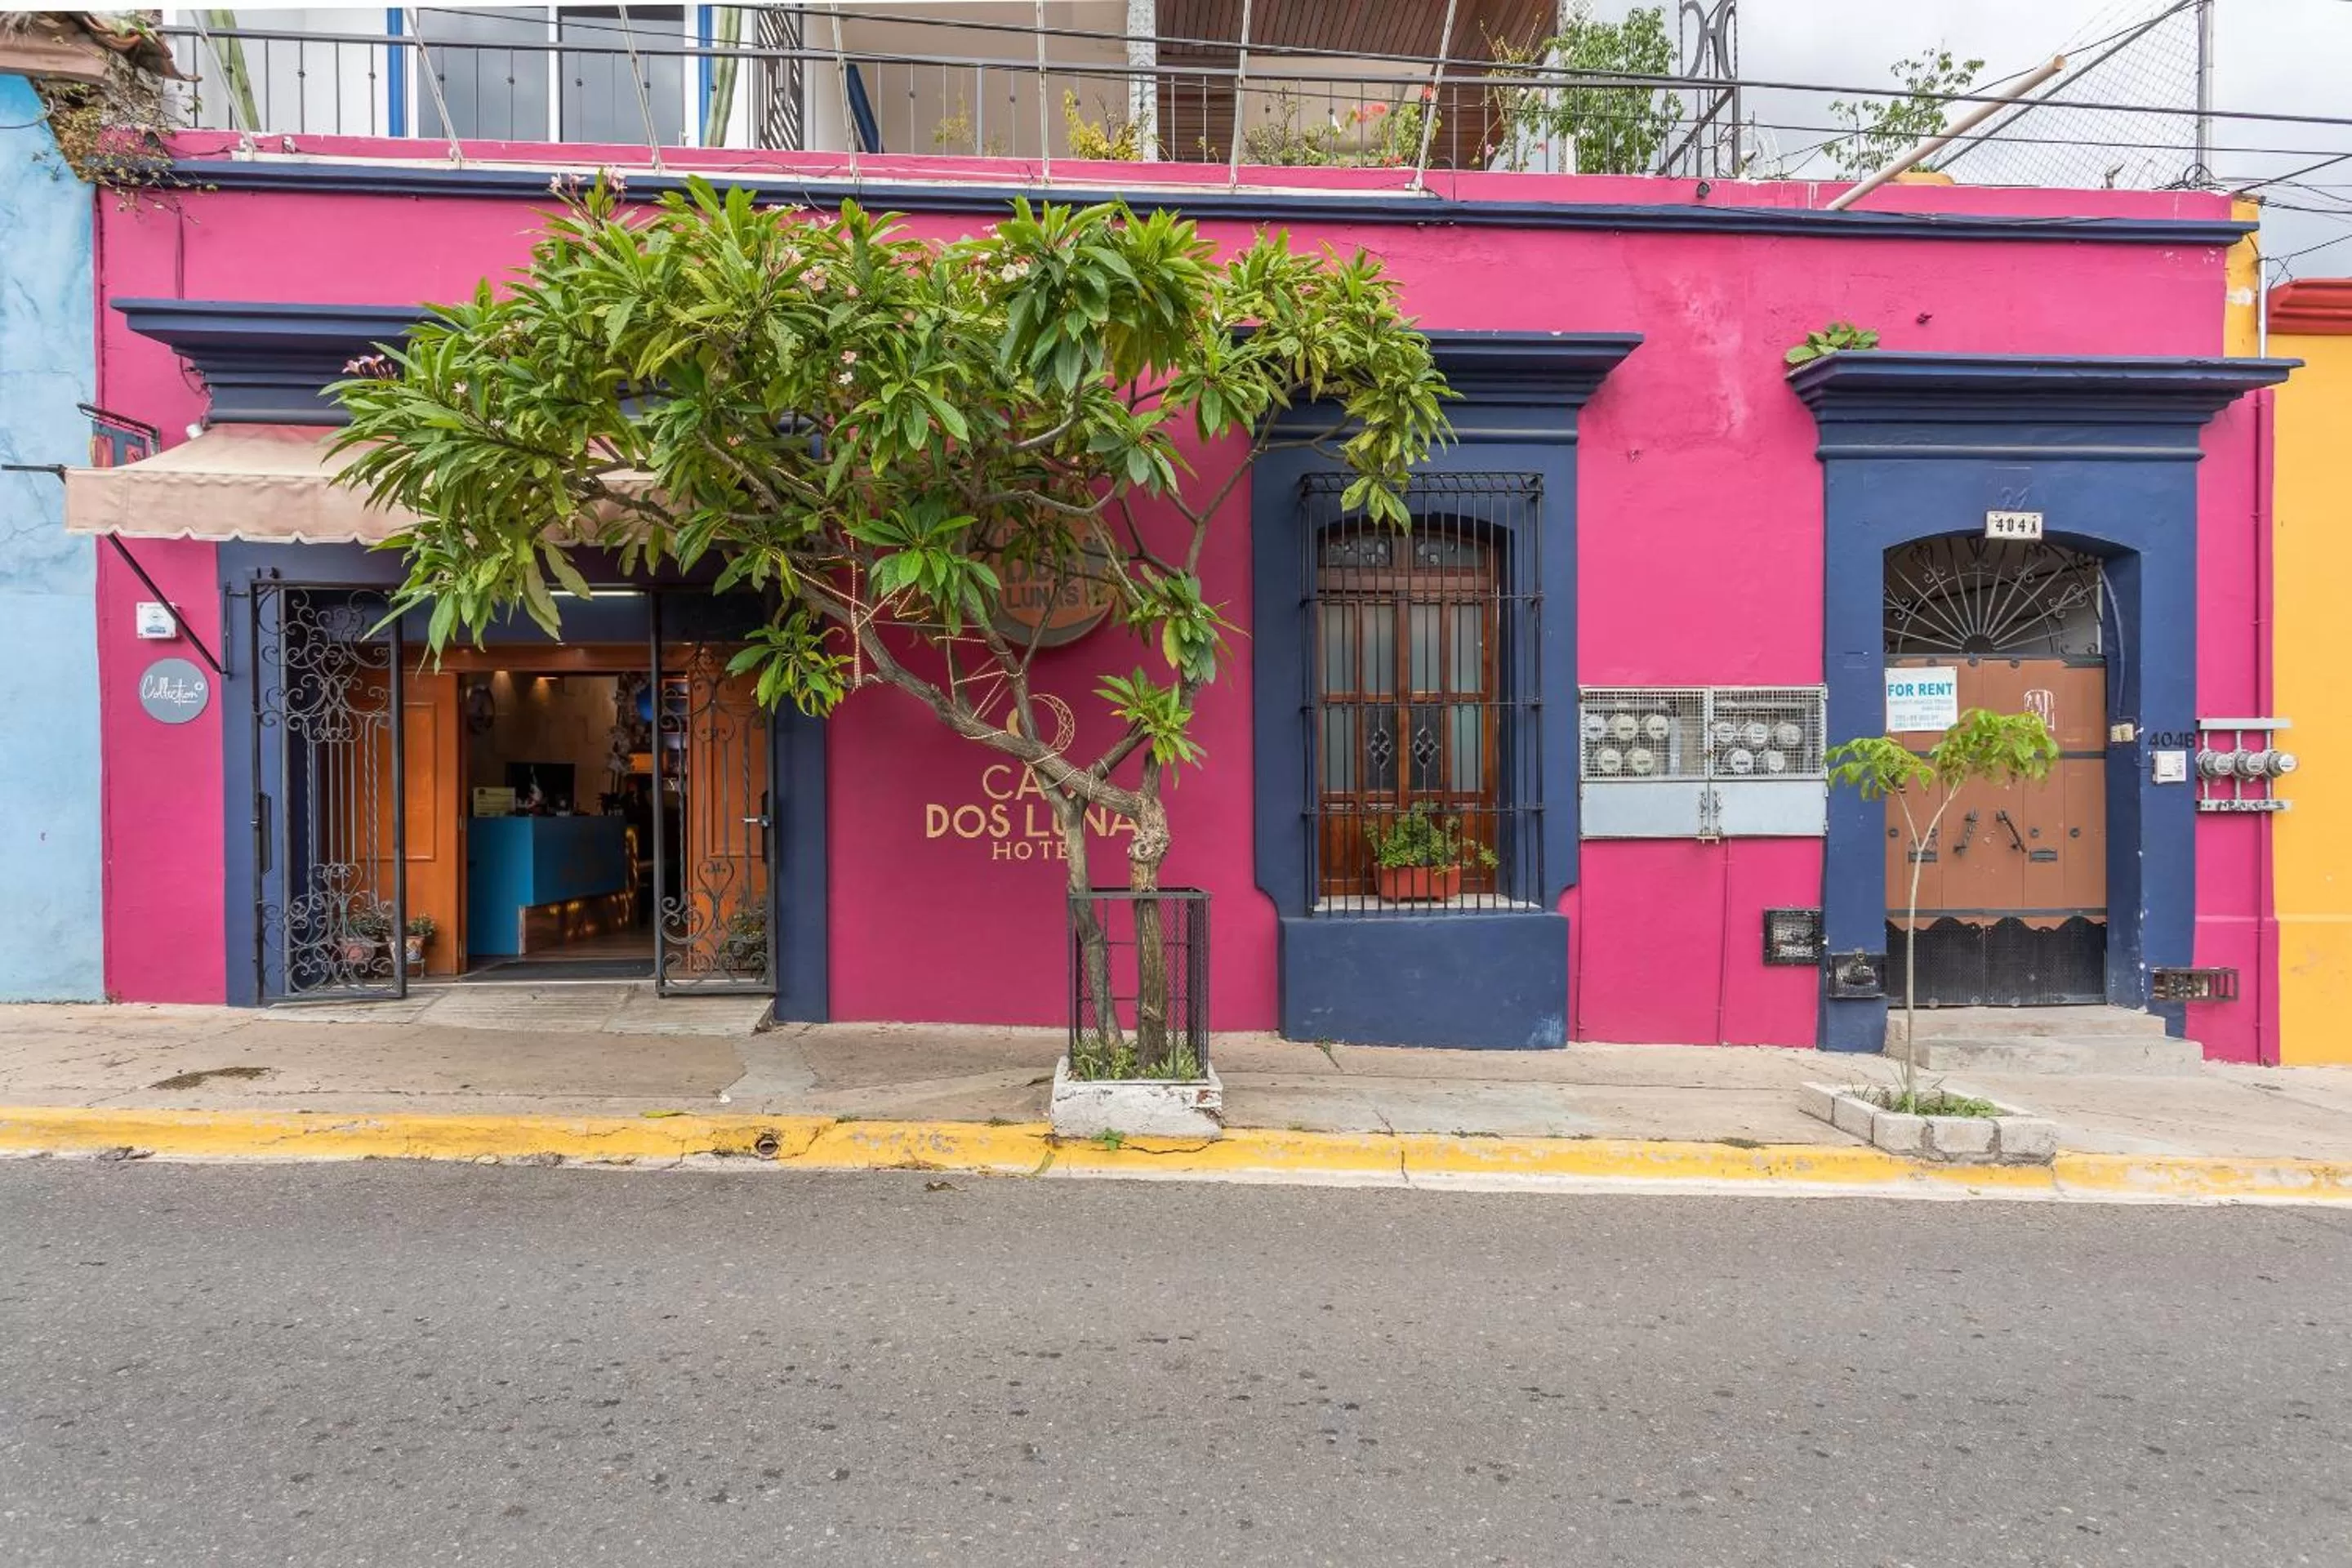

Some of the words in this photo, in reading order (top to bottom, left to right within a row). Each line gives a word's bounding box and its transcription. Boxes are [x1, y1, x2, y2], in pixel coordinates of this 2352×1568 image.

[141, 675, 198, 707] Collection
[1887, 683, 1914, 697] FOR
[1918, 683, 1953, 696] RENT
[2148, 731, 2195, 748] 404B
[982, 764, 1078, 800] CA
[925, 804, 1011, 839] DOS
[1025, 804, 1140, 837] LNA
[991, 841, 1069, 860] HOTE
